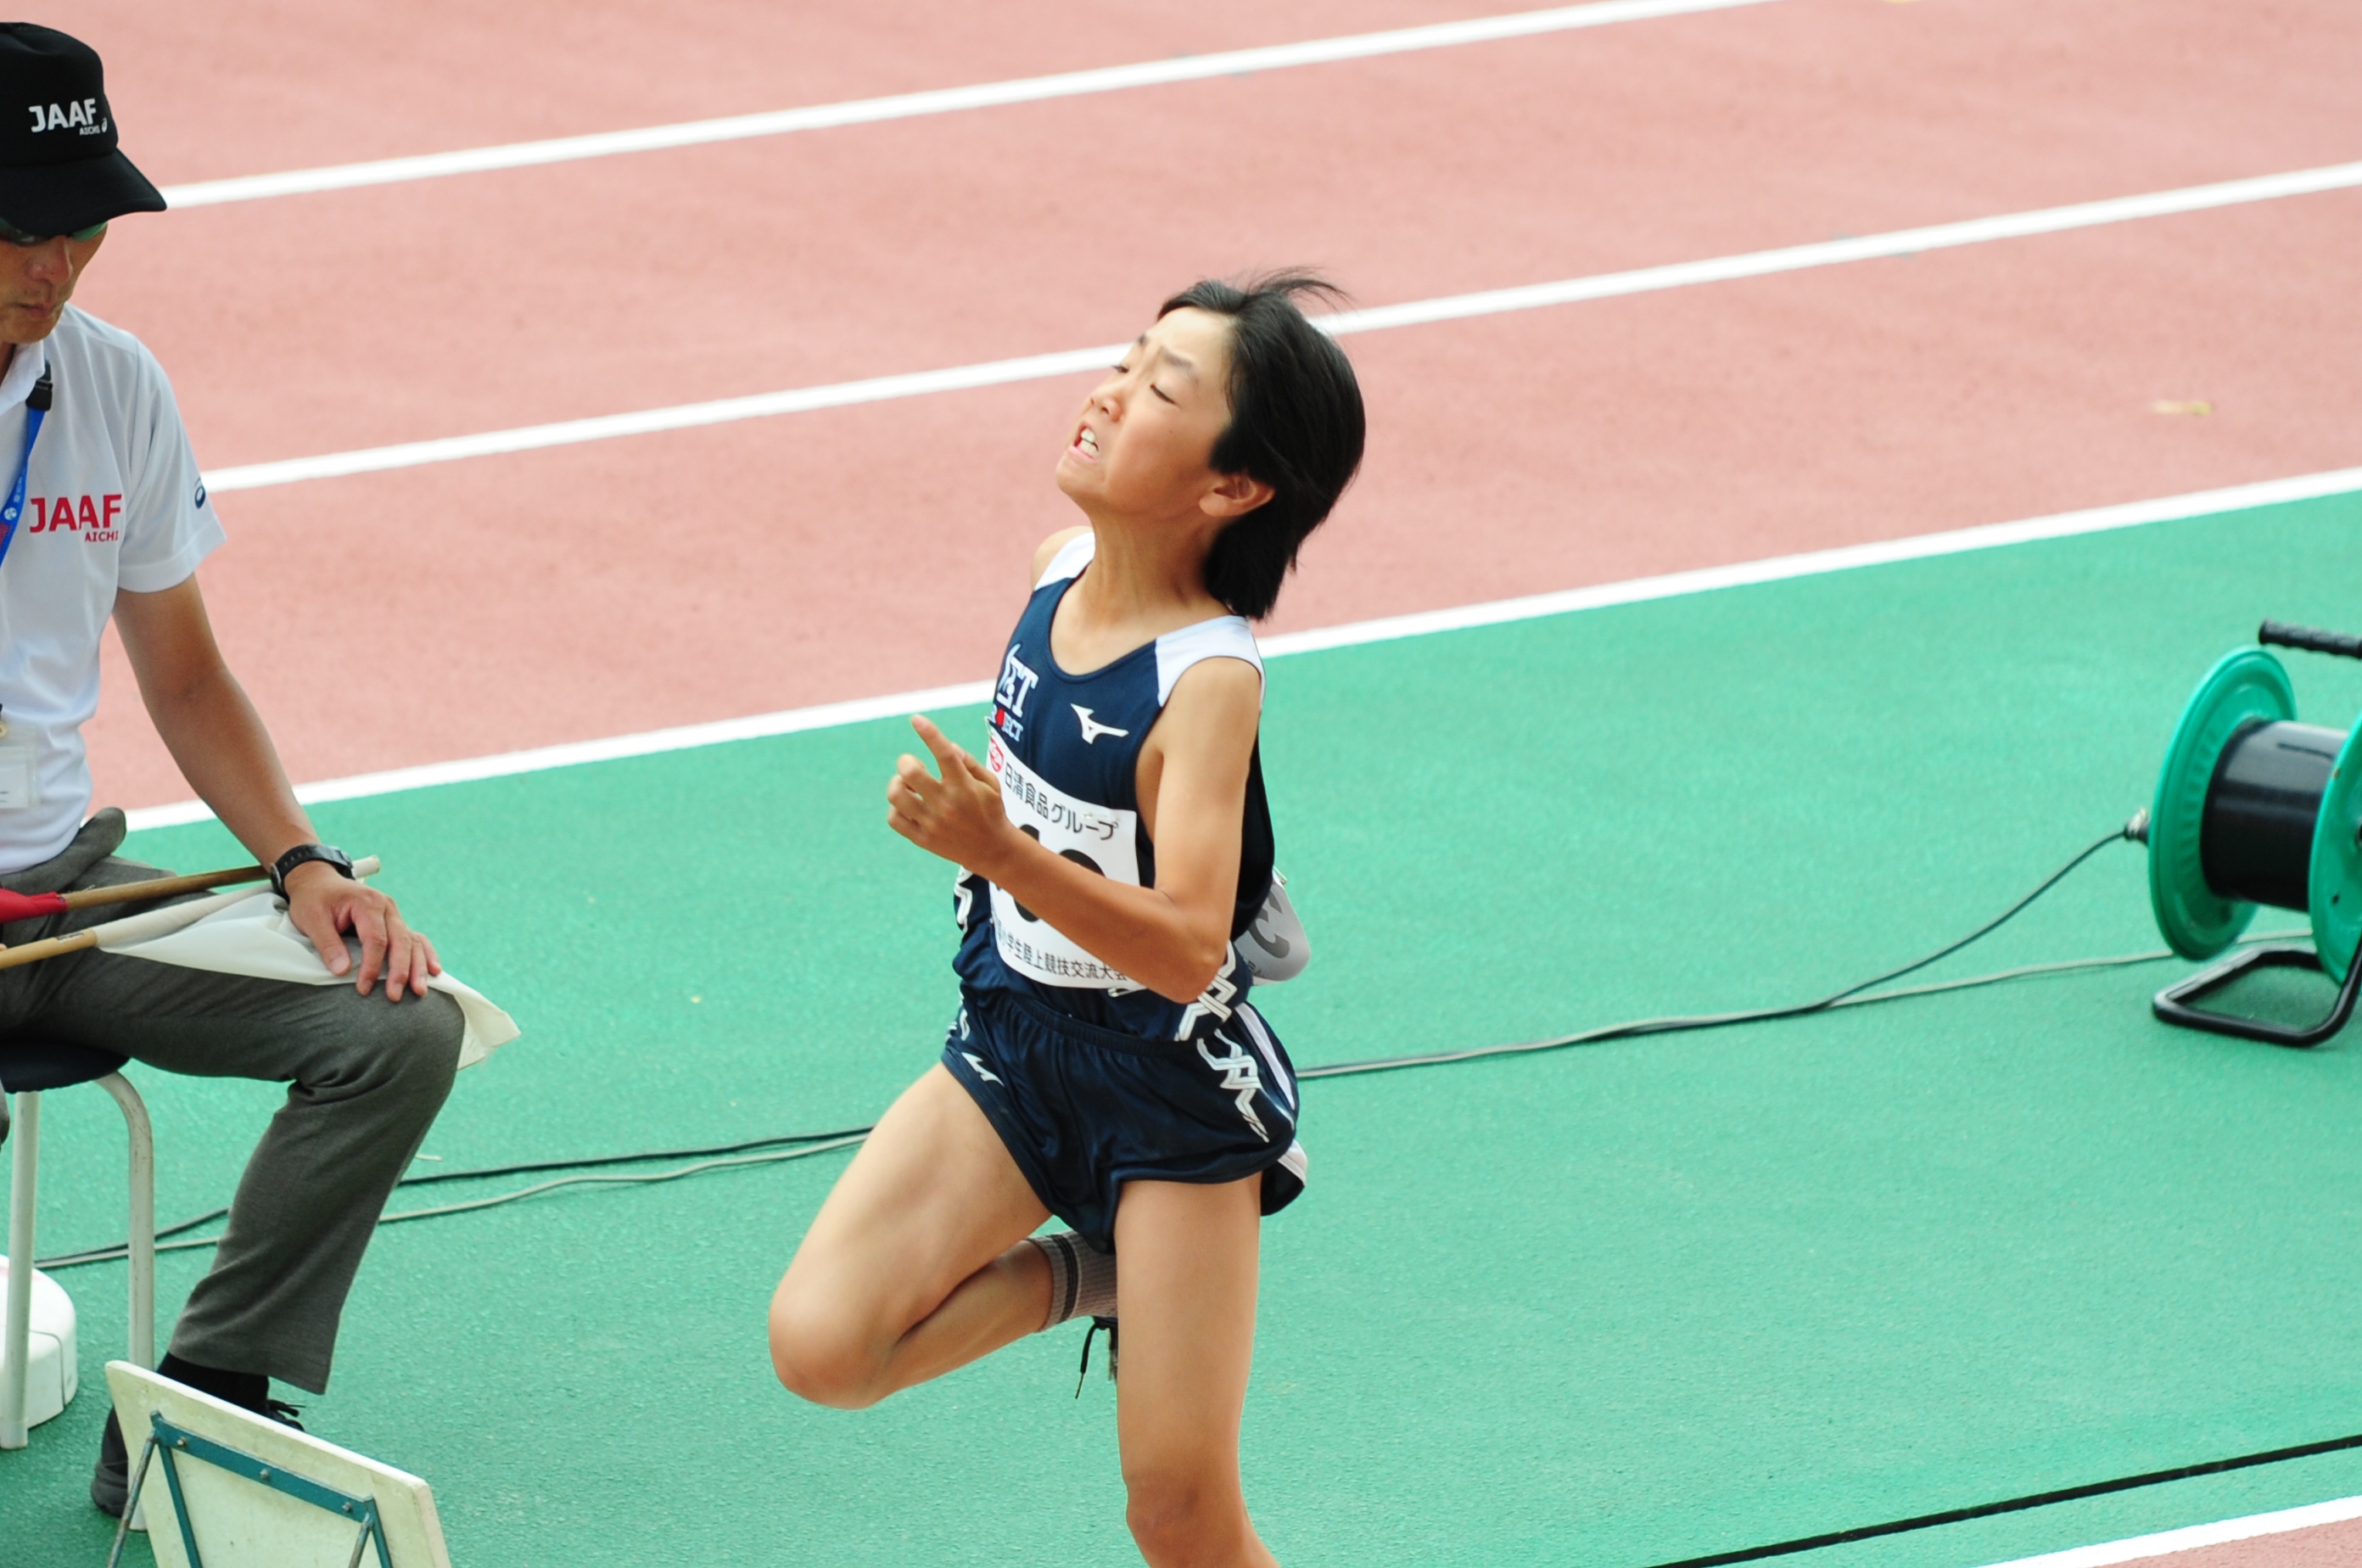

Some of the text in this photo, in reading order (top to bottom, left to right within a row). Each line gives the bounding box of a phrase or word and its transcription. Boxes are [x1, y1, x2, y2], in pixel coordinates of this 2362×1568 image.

[28, 98, 97, 133] JAAF
[29, 494, 122, 534] JAAF
[84, 530, 119, 543] AICHI
[1004, 761, 1119, 841] 日清食品グループ
